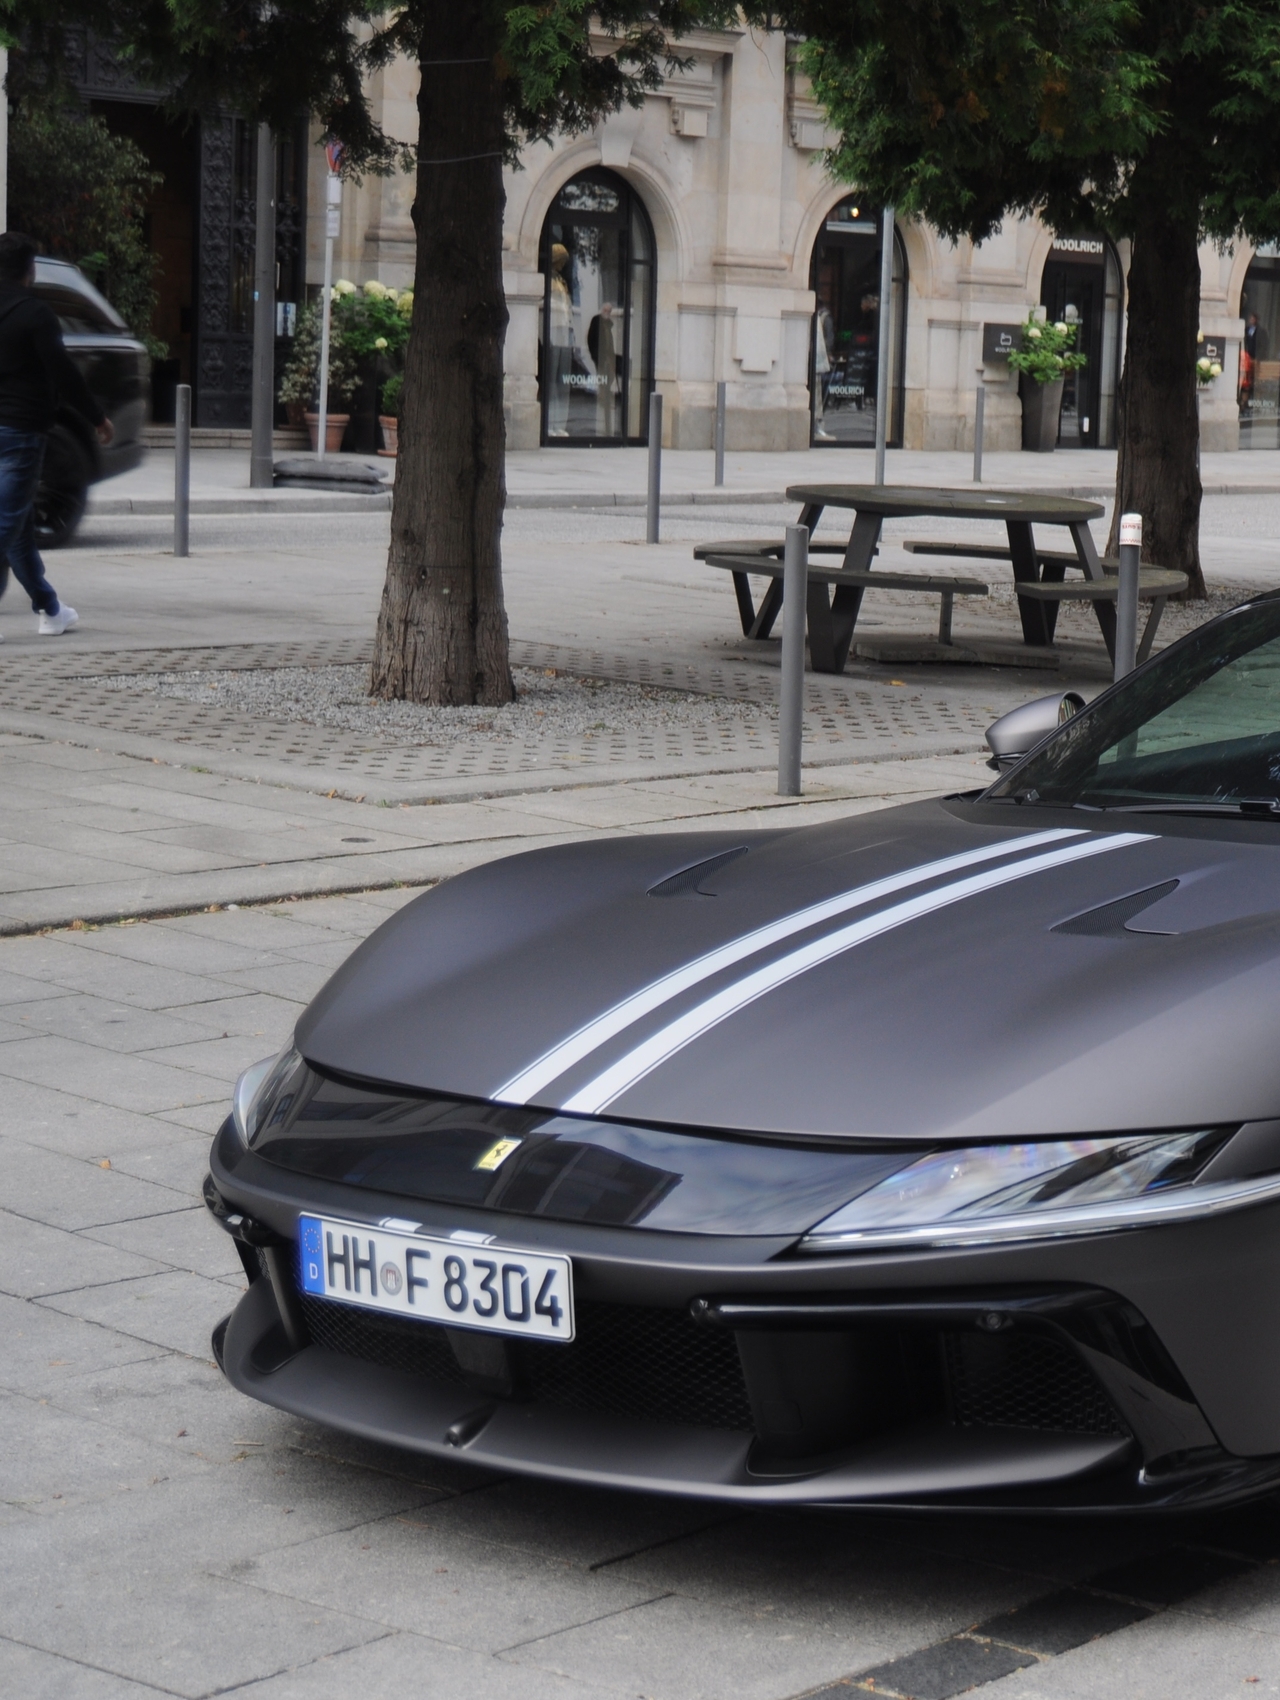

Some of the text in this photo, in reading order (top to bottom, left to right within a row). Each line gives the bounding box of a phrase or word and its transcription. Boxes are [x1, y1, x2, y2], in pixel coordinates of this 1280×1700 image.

[1052, 238, 1104, 254] WOOLRICH
[562, 374, 608, 385] WOOLRICH
[828, 385, 865, 396] WOOLRICH
[309, 1263, 318, 1280] D
[326, 1230, 564, 1328] HH F 8304
